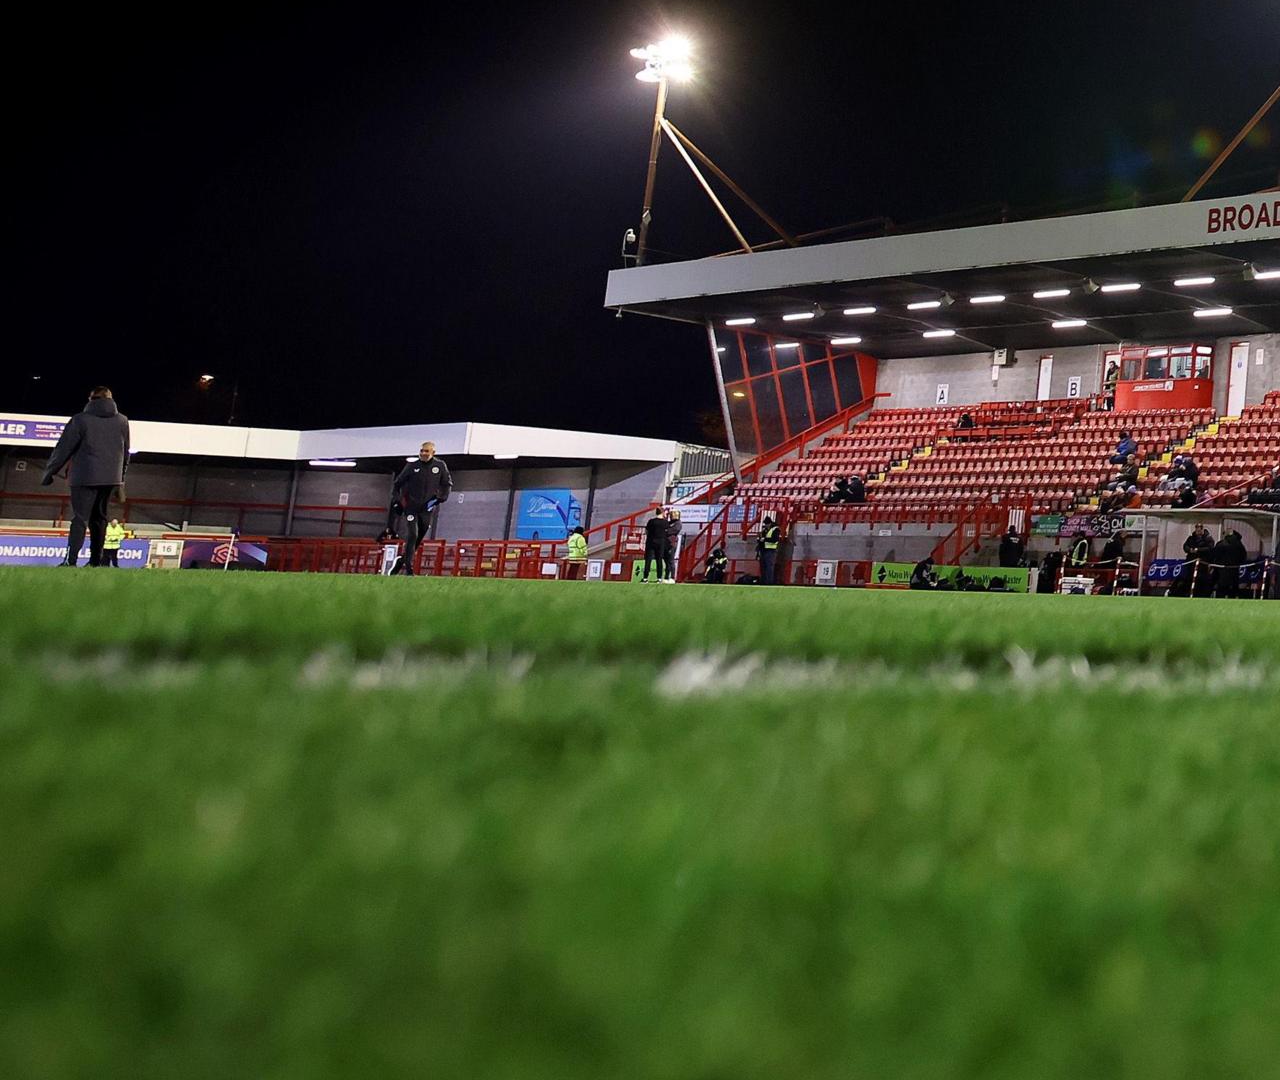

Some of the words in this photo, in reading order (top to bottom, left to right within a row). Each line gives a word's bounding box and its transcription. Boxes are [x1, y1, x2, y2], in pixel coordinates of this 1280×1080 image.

[1070, 383, 1077, 396] B
[938, 390, 945, 402] A
[162, 545, 172, 553] 16
